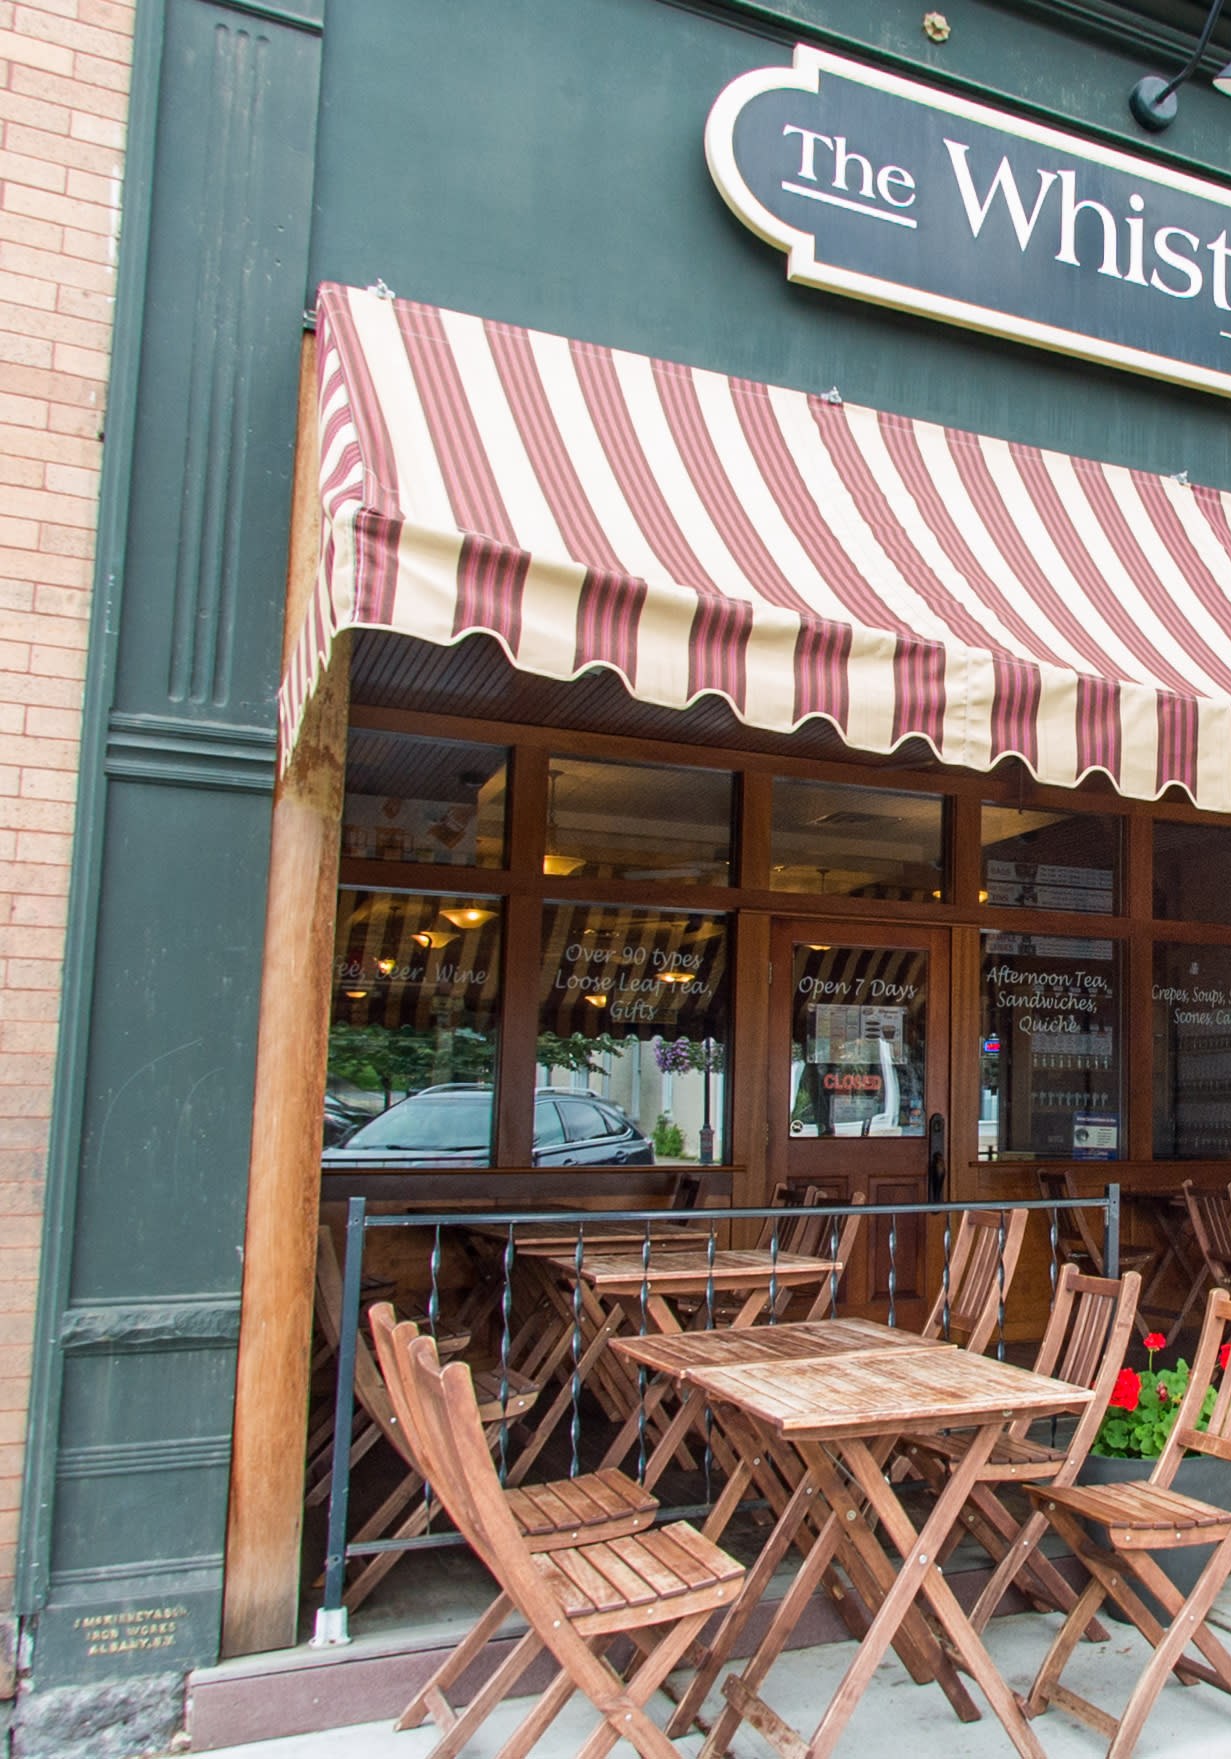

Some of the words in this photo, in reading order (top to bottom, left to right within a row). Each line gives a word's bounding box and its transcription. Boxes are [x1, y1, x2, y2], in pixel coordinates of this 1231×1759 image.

[782, 124, 915, 208] The
[565, 943, 617, 963] Over
[622, 946, 646, 965] 90
[652, 947, 704, 972] types
[435, 962, 489, 985] Wine
[555, 969, 617, 991] Loose
[619, 972, 666, 997] Leaf
[986, 964, 1073, 986] Afternoon
[1074, 971, 1108, 990] Tea,
[799, 976, 852, 1000] Open
[855, 979, 865, 995] 7
[870, 980, 918, 1002] Days
[996, 990, 1098, 1013] Sandwiches,
[609, 998, 659, 1022] Gifts
[823, 1073, 882, 1090] CLOSED
[126, 1621, 176, 1636] WORKS
